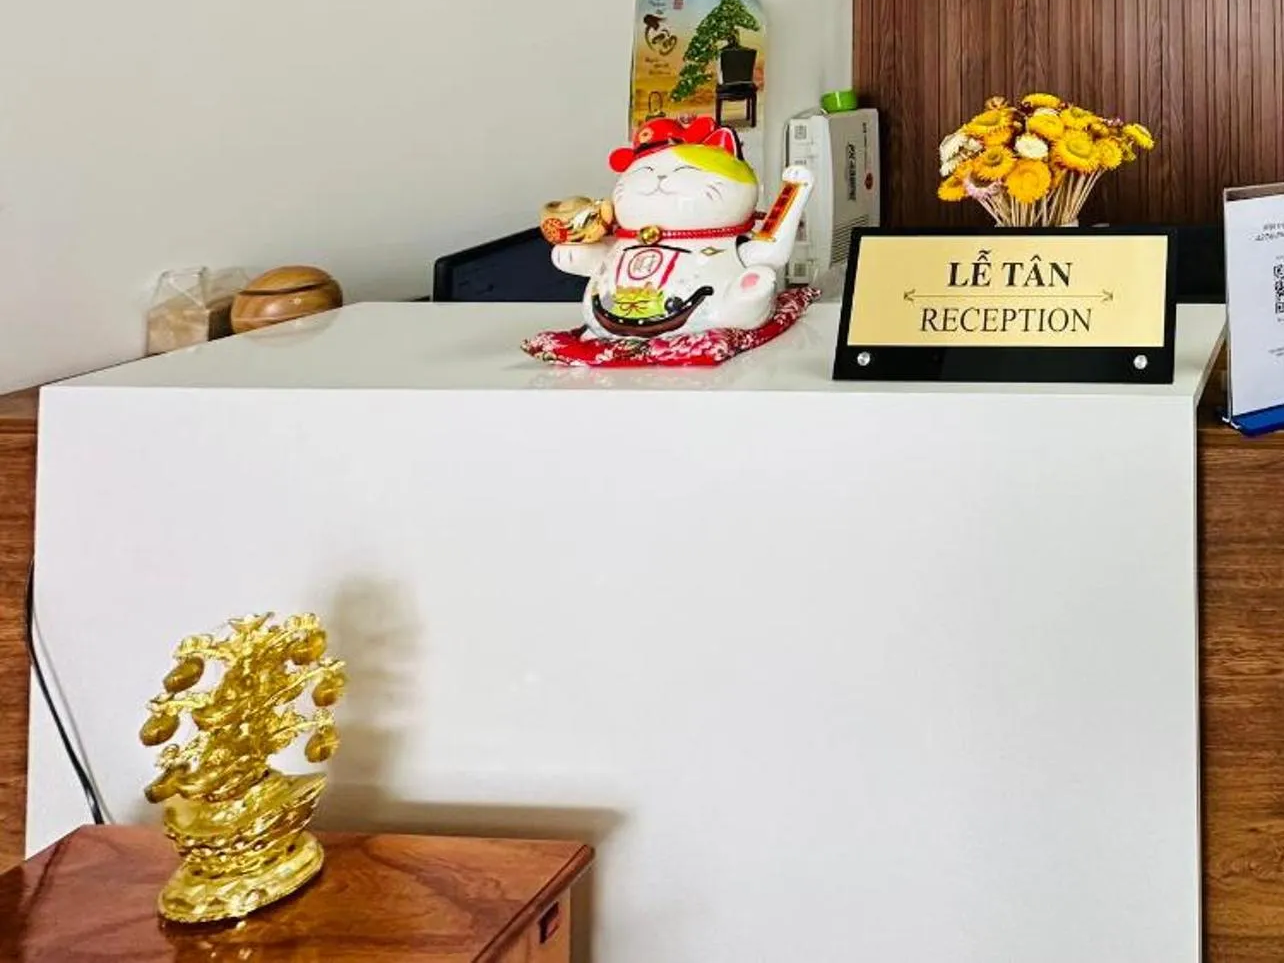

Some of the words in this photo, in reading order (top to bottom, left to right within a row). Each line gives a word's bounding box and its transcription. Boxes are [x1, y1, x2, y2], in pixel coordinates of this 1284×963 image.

[947, 249, 992, 288] LỄ
[1001, 254, 1073, 288] TÂN
[920, 307, 1092, 333] RECEPTION
